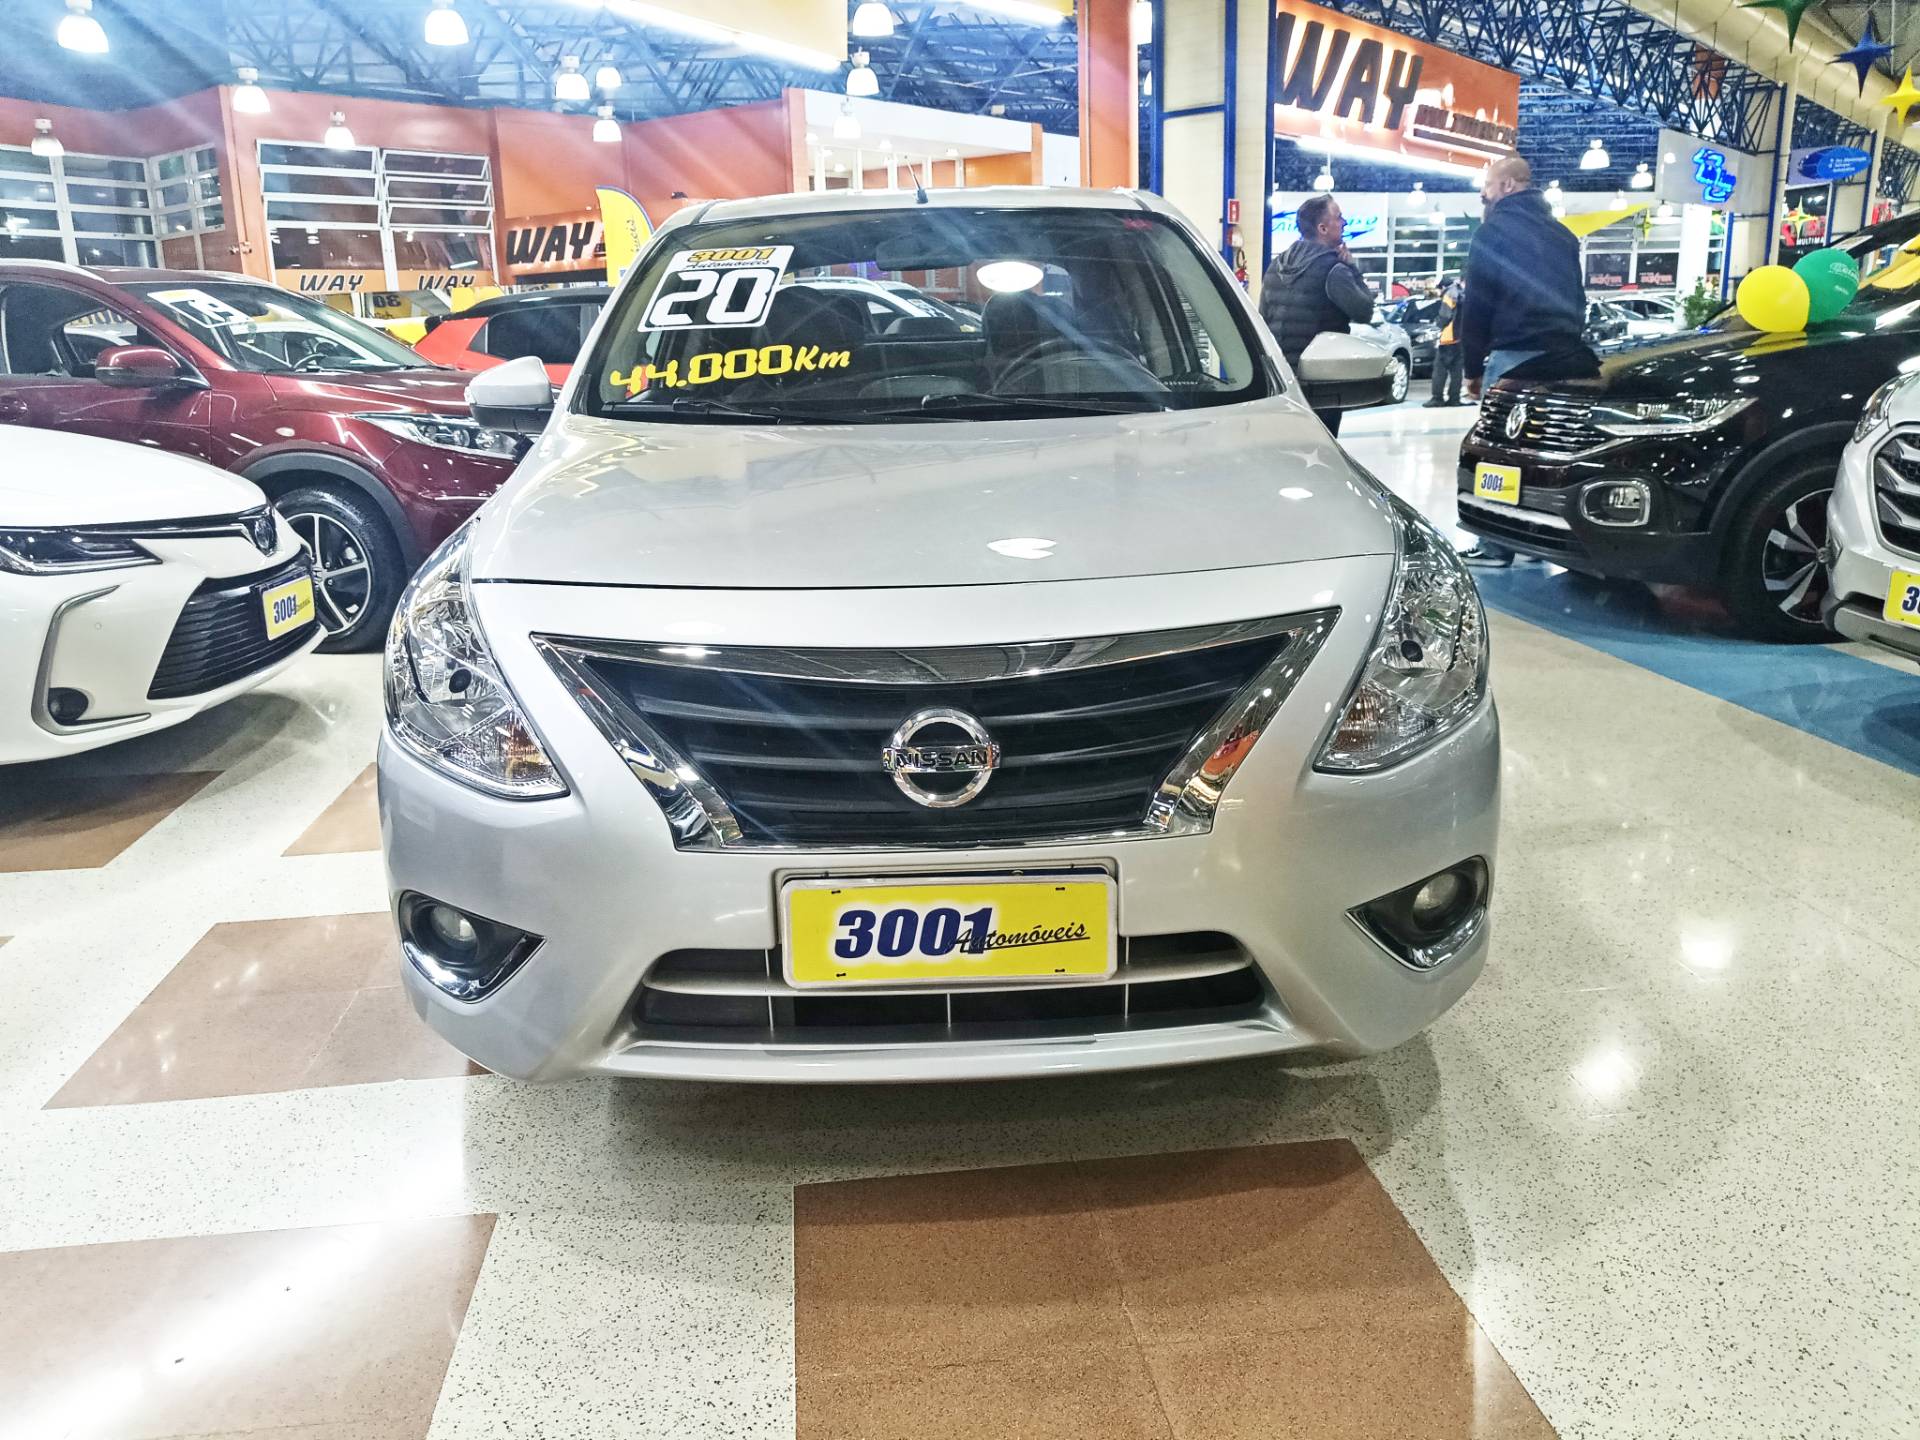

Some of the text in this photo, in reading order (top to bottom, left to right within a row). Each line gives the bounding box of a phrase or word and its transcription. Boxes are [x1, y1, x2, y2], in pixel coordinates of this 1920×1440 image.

[1276, 12, 1424, 130] WAY
[506, 221, 595, 264] WAY
[687, 248, 776, 262] 3001
[300, 275, 363, 291] WAY
[418, 275, 474, 291] WAY
[649, 268, 777, 325] 20
[1481, 473, 1503, 491] 3001
[273, 594, 296, 624] 3001
[896, 749, 988, 768] NISSAN
[835, 907, 1090, 958] 3001 Automóveis
